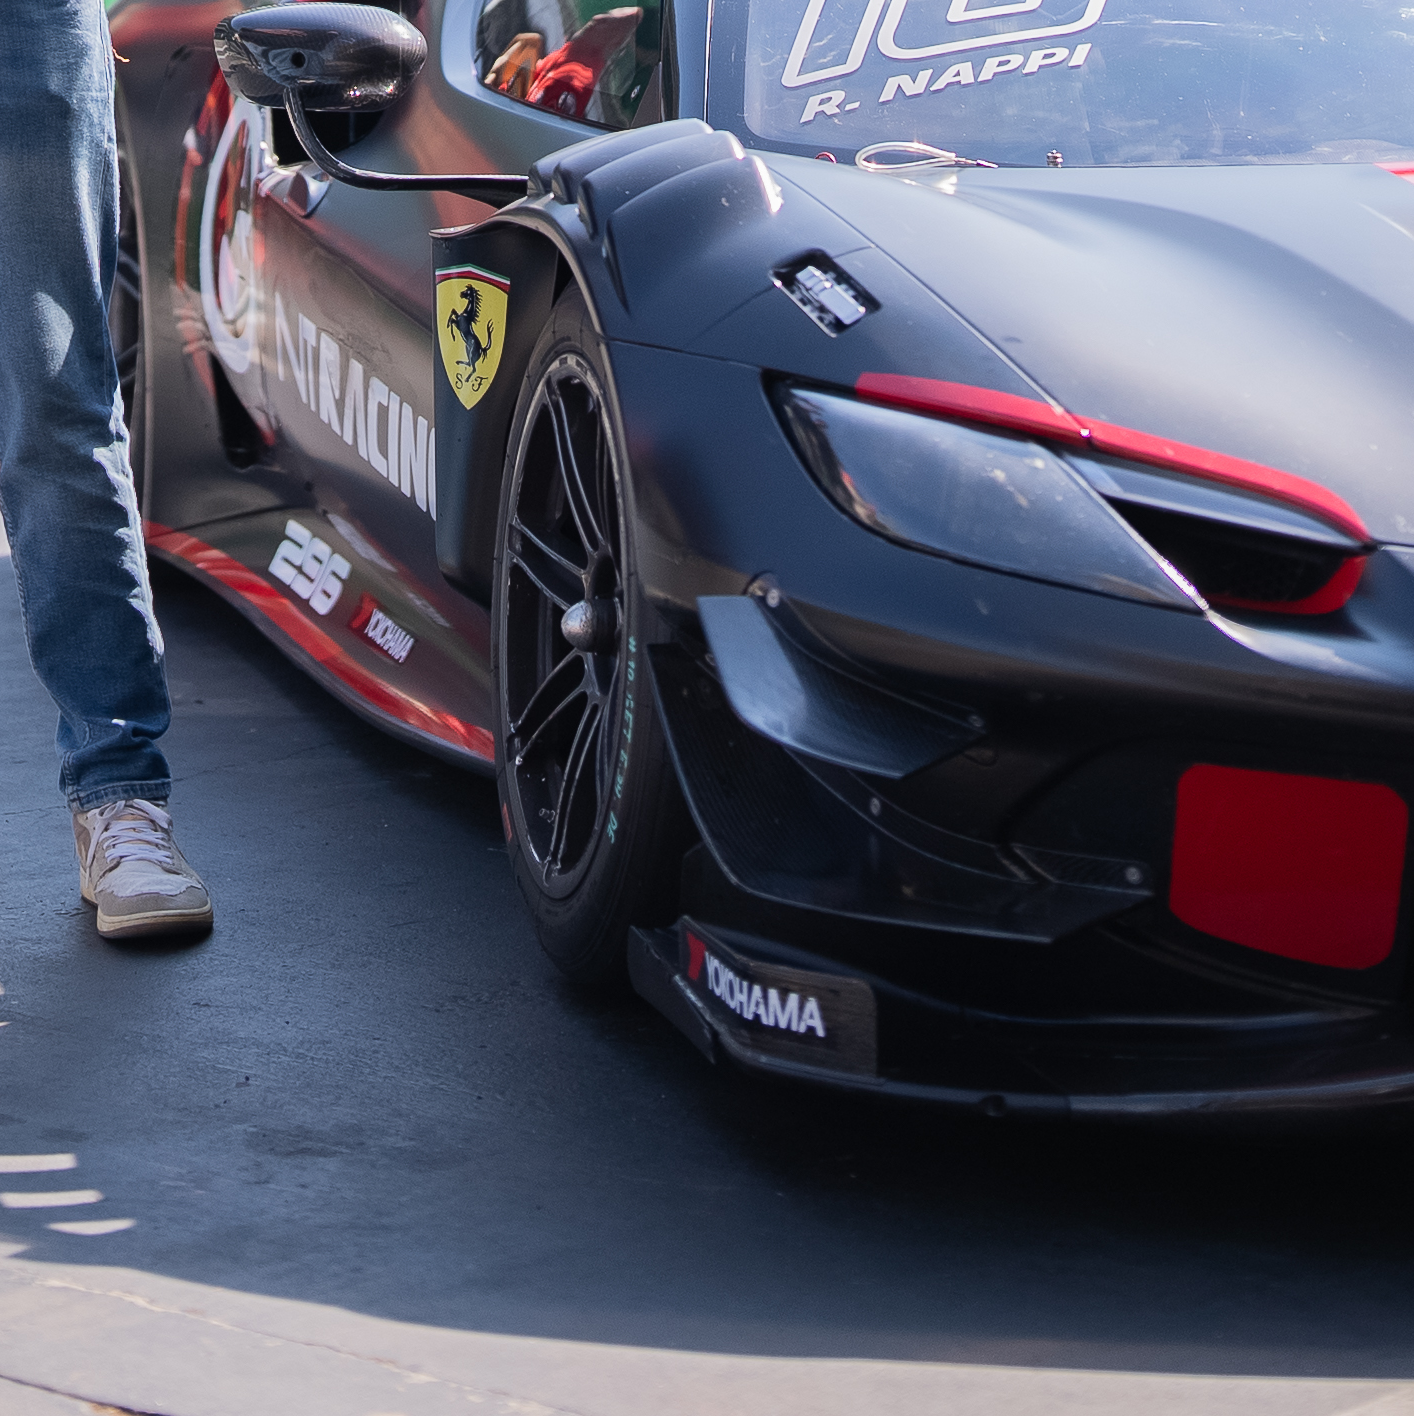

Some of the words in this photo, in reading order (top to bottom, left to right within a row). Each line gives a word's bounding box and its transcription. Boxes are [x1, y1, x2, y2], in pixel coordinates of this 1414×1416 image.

[799, 90, 860, 124] R.
[878, 42, 1093, 103] NAPPI
[268, 518, 353, 616] 296
[364, 607, 415, 664] YOKOHAMA
[704, 950, 826, 1038] YOKOHAMA
